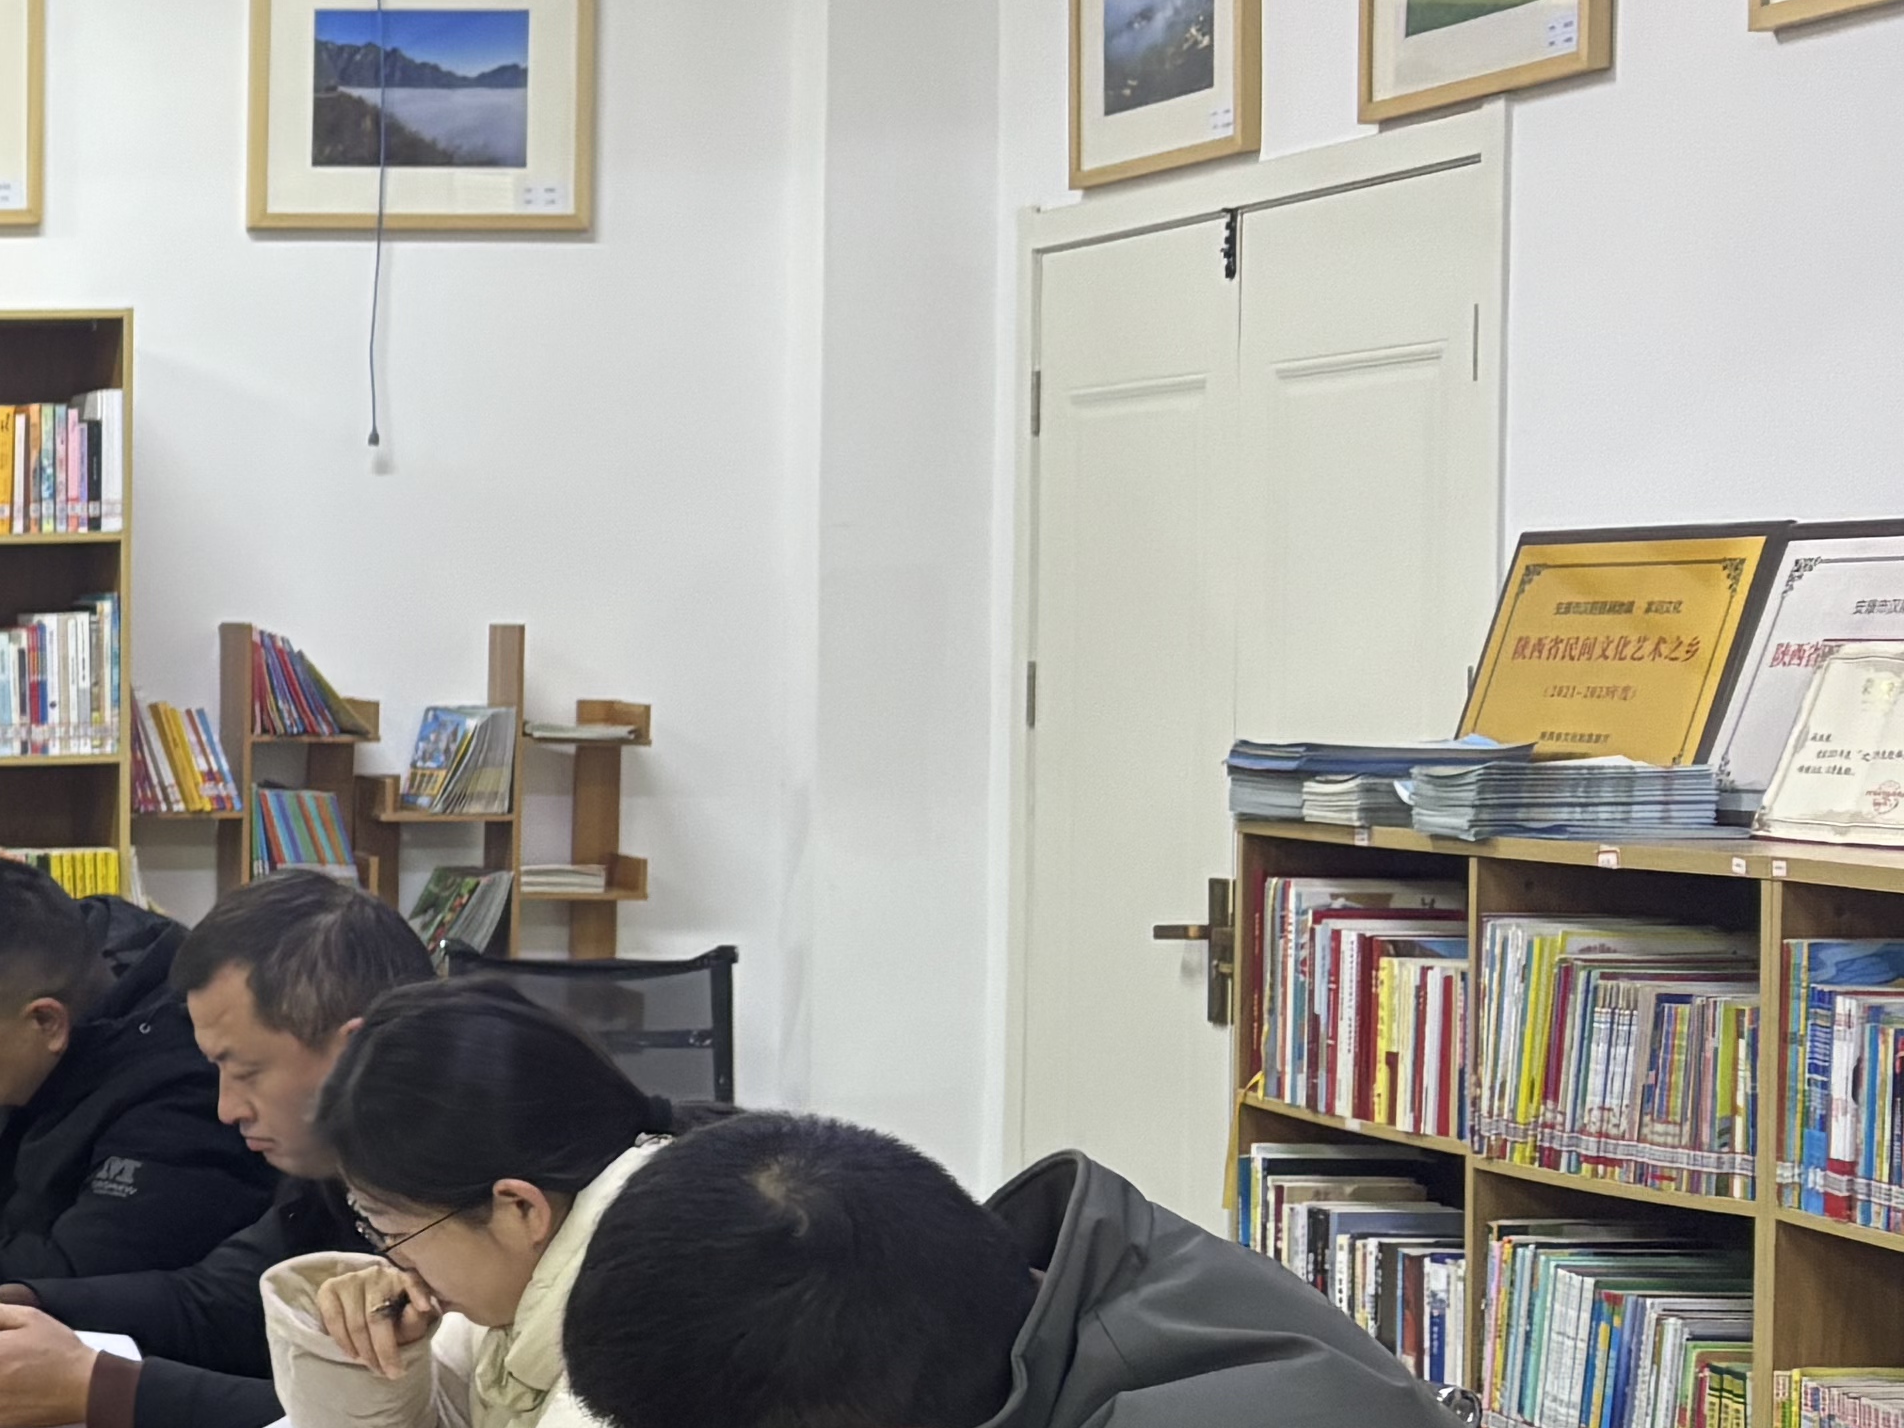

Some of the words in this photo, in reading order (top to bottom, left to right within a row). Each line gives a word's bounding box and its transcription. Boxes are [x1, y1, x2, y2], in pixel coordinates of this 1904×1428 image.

[1512, 635, 1702, 664] 陕西省民间文化艺术之乡
